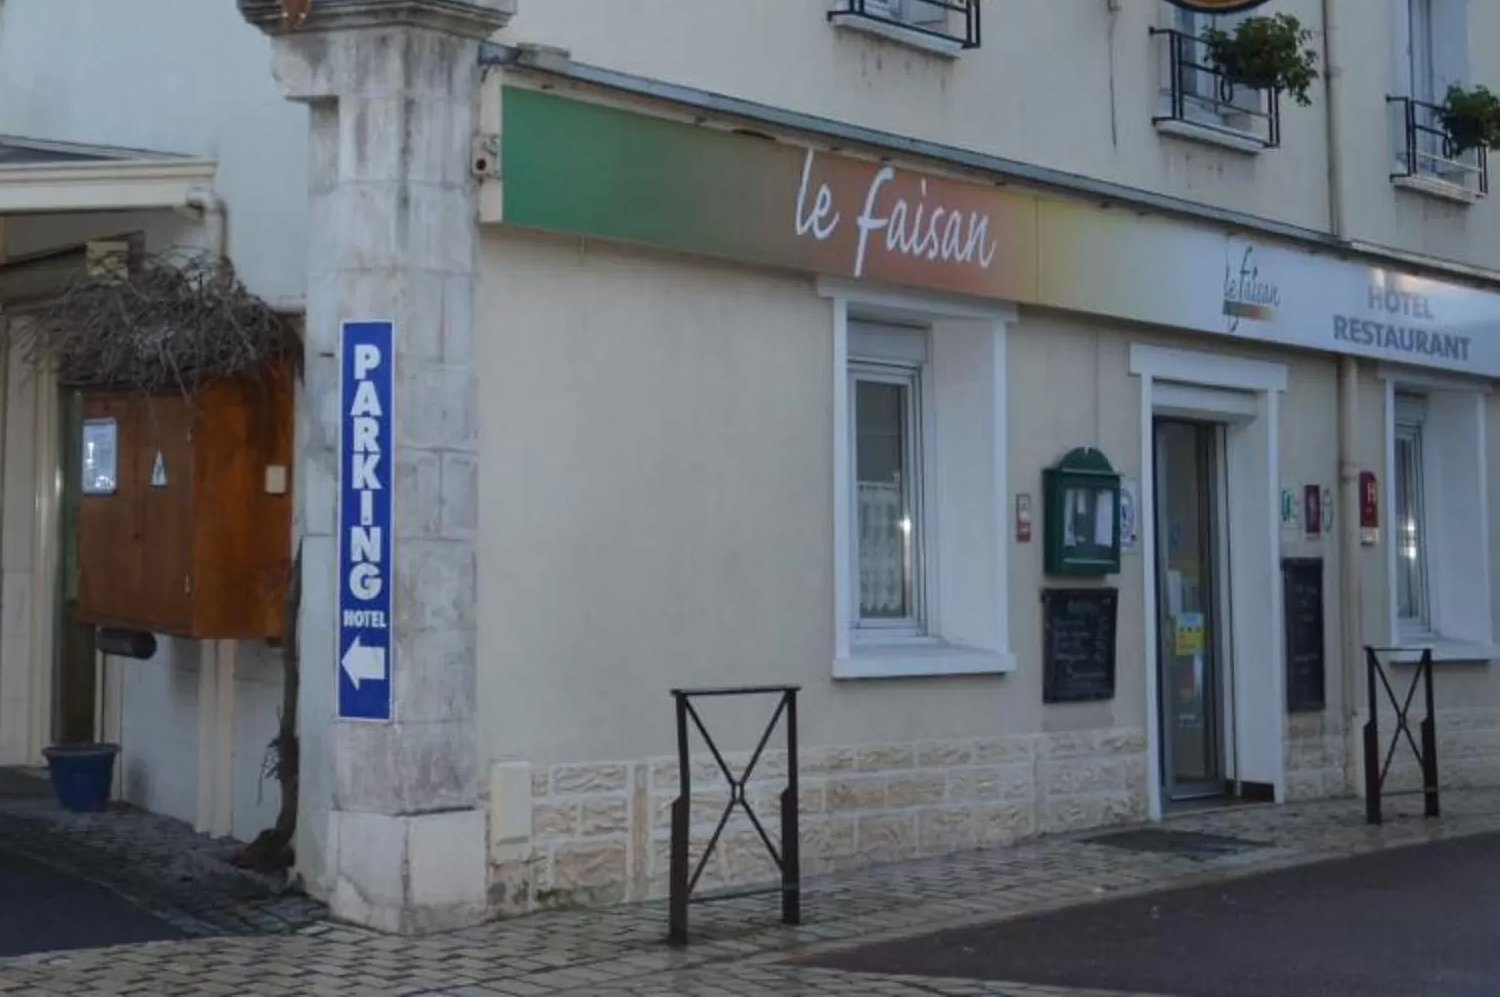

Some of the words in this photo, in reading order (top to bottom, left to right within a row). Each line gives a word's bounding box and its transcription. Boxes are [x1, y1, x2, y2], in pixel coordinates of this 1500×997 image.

[1332, 314, 1472, 361] RESTAURANT
[349, 344, 383, 601] PARKING
[343, 609, 387, 628] HOTEL
